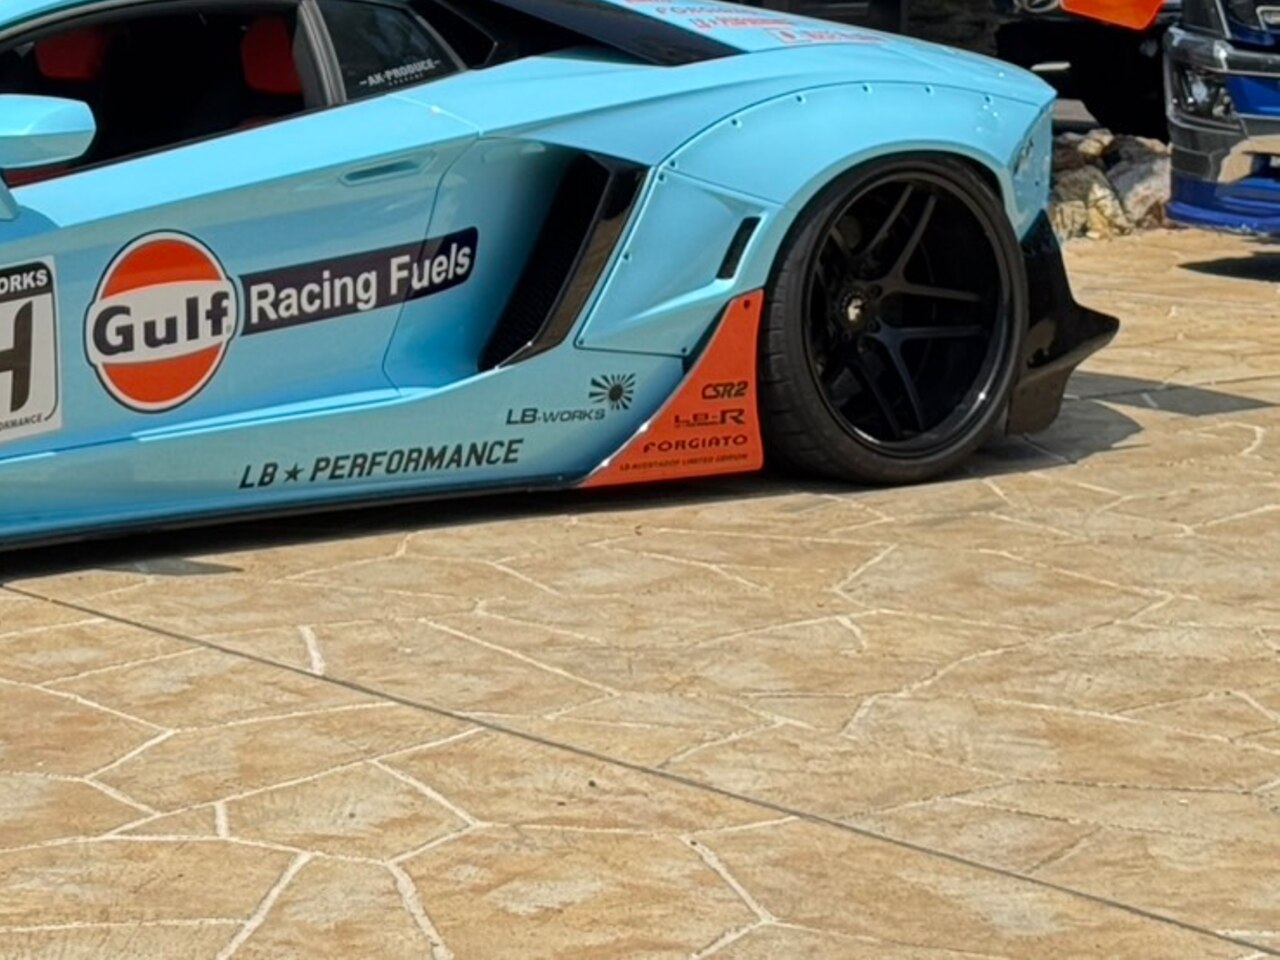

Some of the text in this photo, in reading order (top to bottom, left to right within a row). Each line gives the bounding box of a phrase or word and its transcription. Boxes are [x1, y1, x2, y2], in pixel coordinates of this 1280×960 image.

[249, 241, 473, 327] Racing Fuels
[93, 290, 232, 356] Gulf
[701, 380, 749, 400] CSR2
[310, 437, 526, 483] PERFORMANCE
[643, 434, 749, 454] FORGIATO
